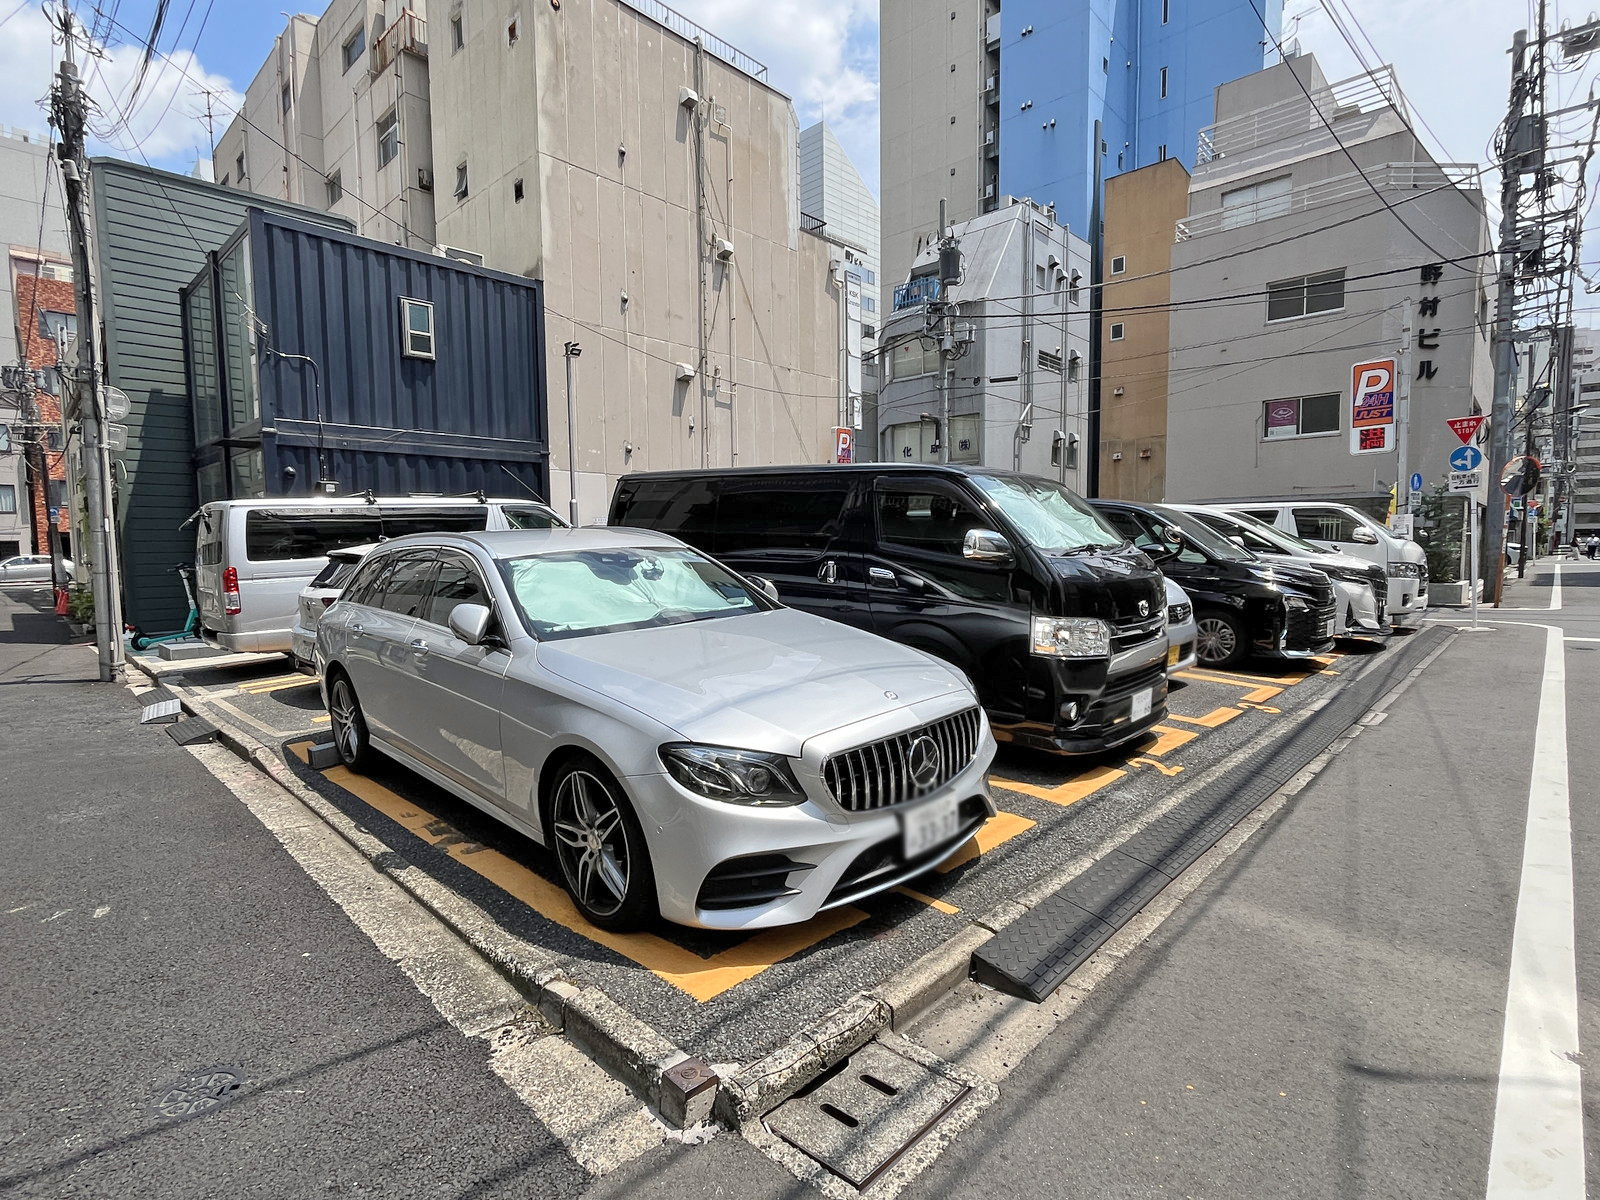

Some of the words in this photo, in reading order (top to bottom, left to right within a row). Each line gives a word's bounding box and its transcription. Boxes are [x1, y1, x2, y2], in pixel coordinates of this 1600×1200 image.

[1416, 265, 1443, 380] 野村ビル
[1354, 368, 1391, 407] P
[1362, 393, 1390, 408] 24H
[1453, 420, 1477, 429] 止まれ
[1457, 427, 1474, 435] STOP
[837, 433, 850, 456] P
[1360, 428, 1385, 450] 満
[1127, 757, 1185, 777] 2
